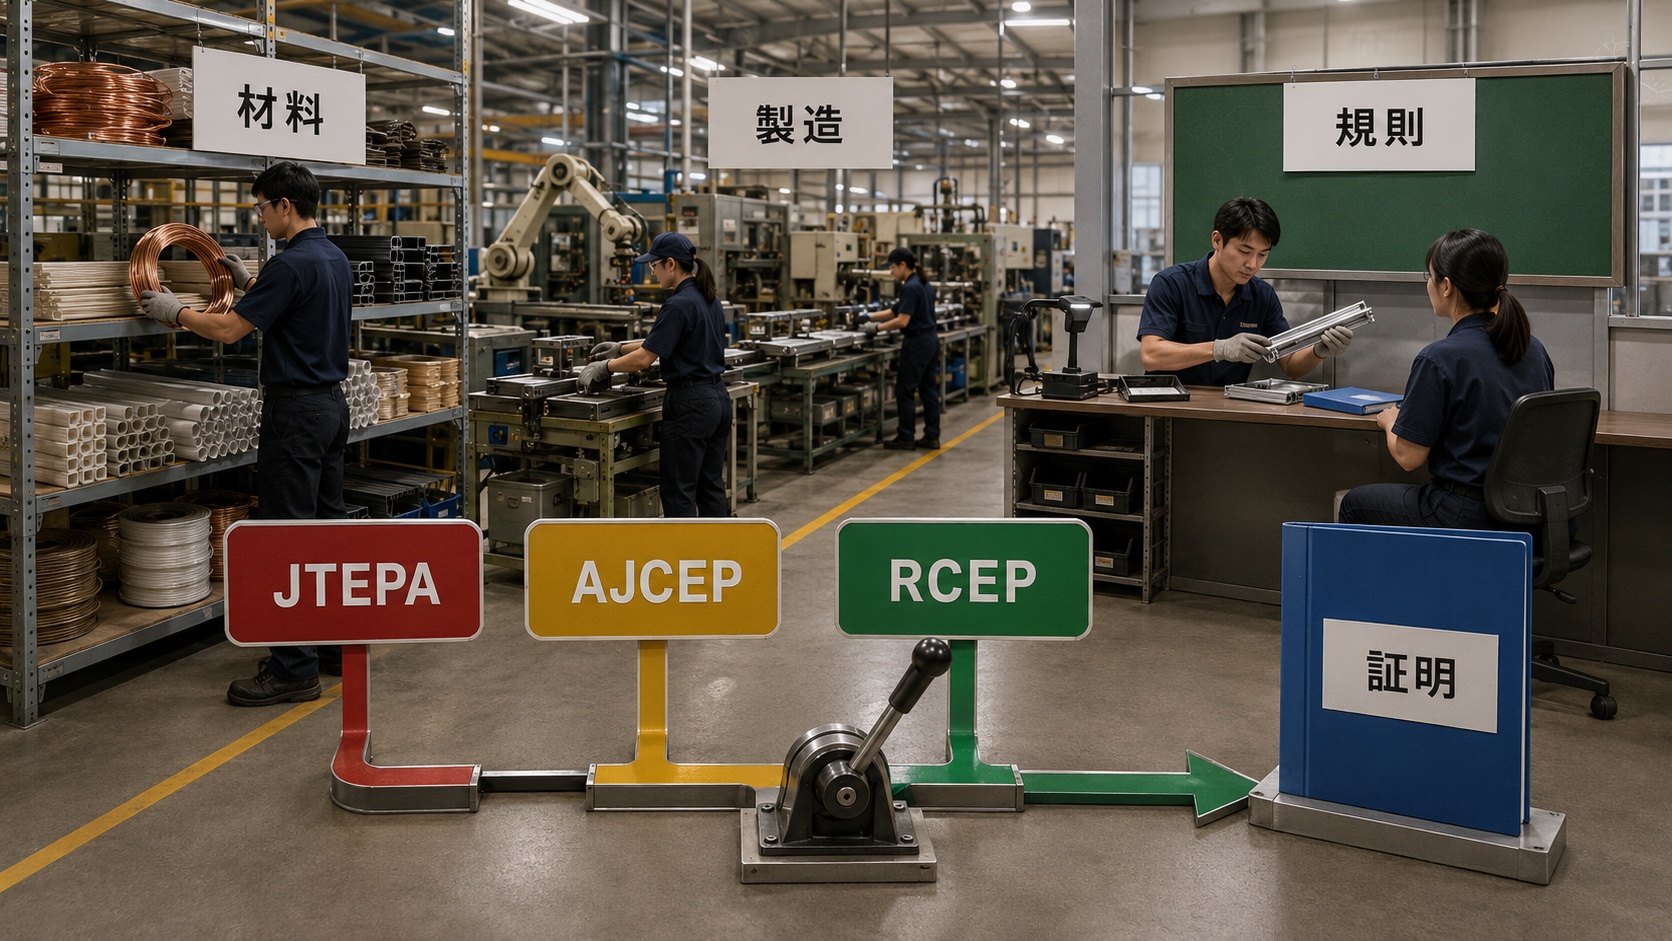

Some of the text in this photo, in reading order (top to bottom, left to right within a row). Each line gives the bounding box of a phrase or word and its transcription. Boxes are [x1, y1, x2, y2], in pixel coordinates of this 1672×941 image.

[237, 84, 324, 136] 材料
[755, 105, 843, 146] 製造
[1336, 107, 1424, 147] 規則
[274, 562, 441, 608] JTEPA
[571, 560, 742, 604] AJCEP
[890, 559, 1037, 603] RCEP
[1367, 650, 1456, 701] 証明
